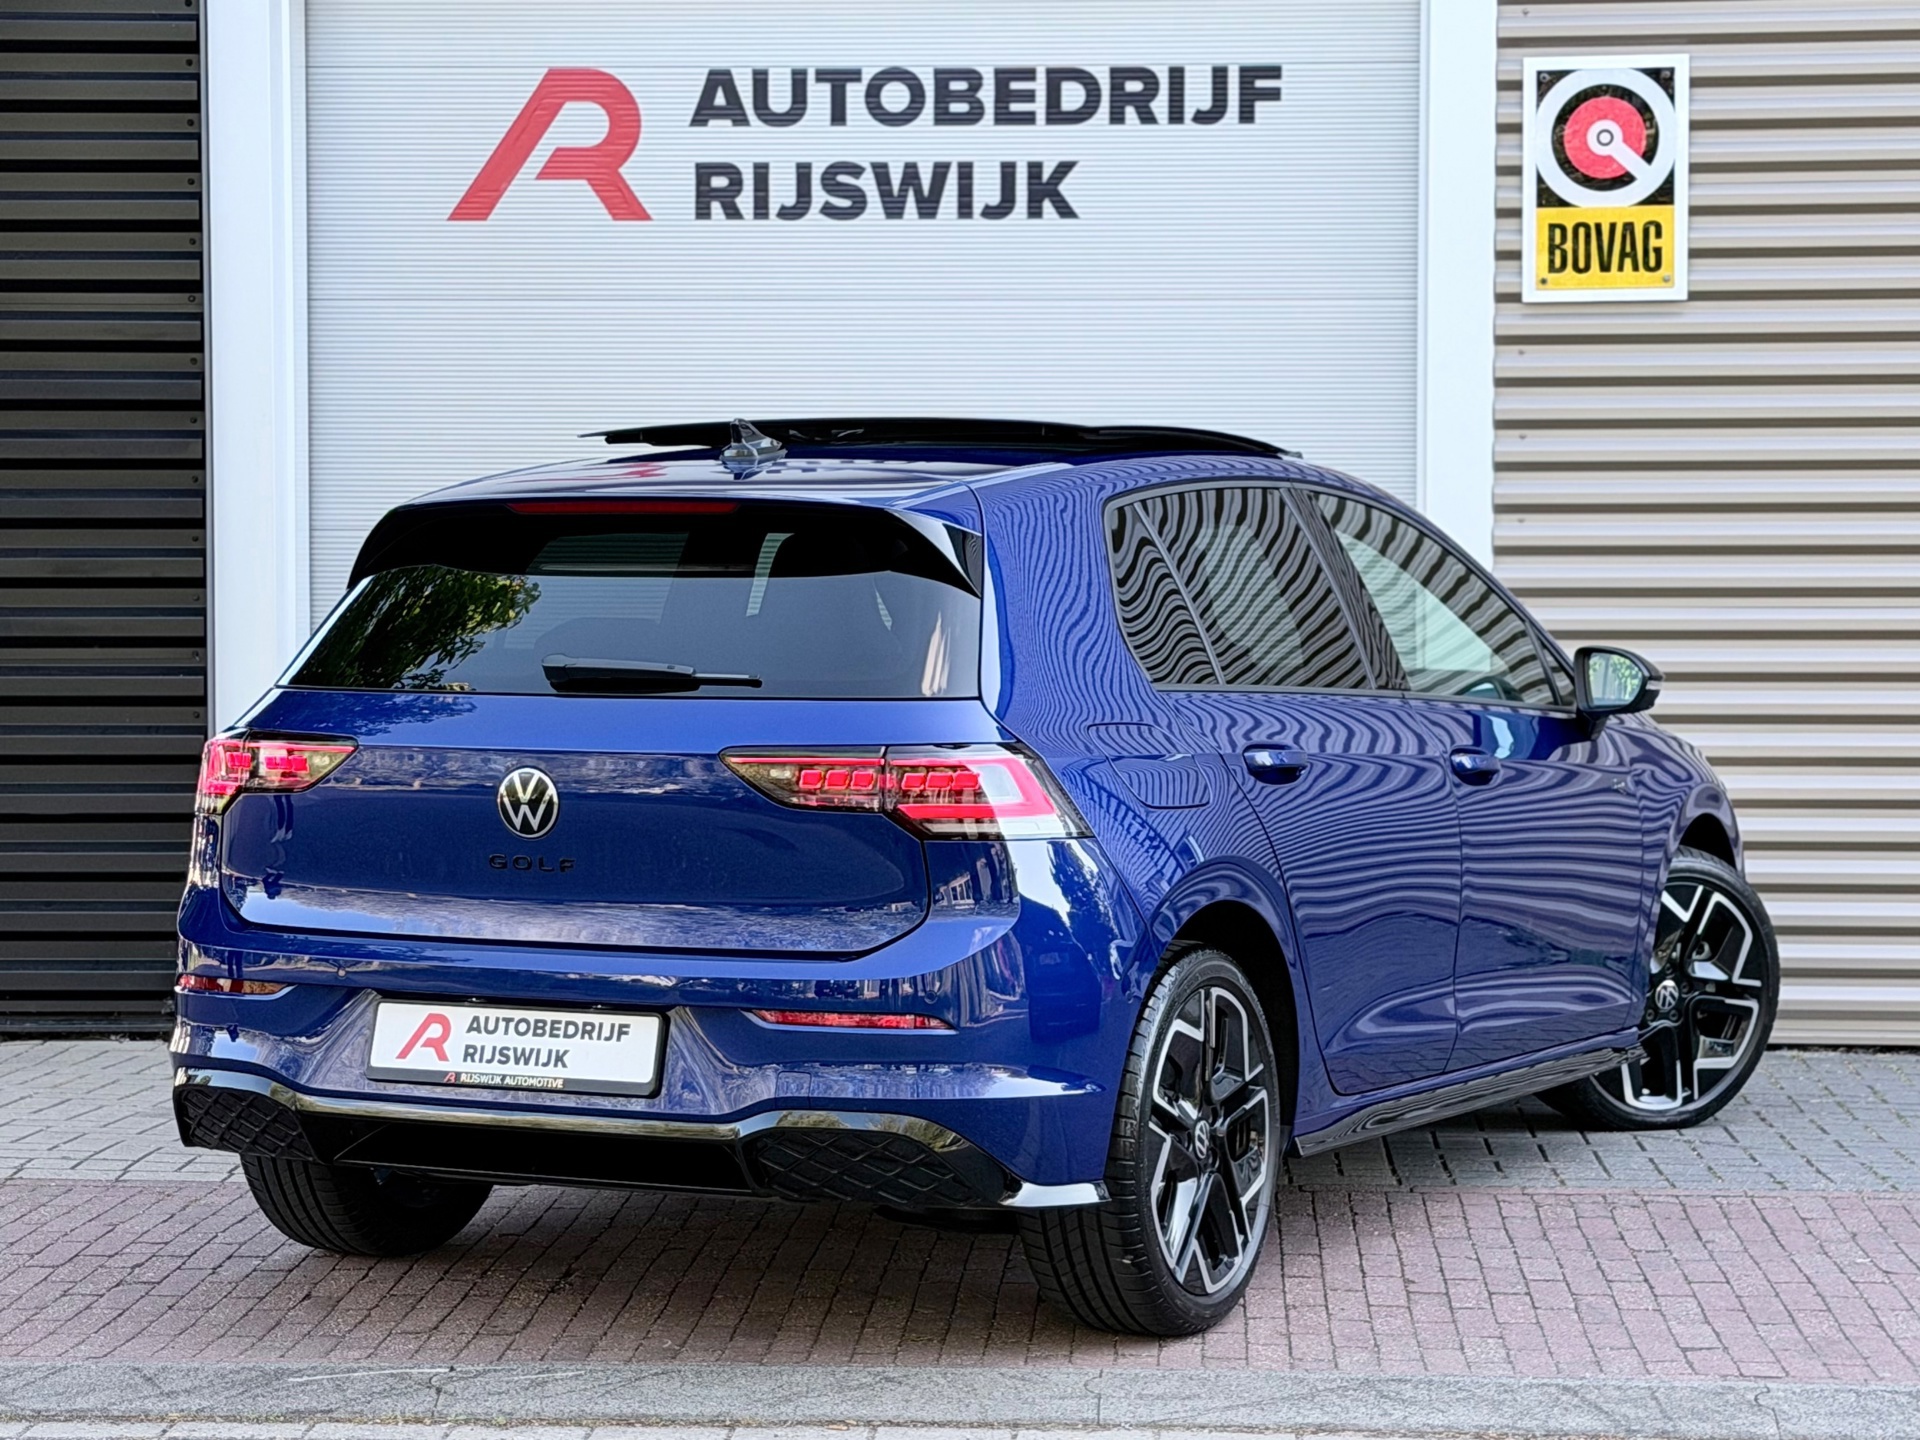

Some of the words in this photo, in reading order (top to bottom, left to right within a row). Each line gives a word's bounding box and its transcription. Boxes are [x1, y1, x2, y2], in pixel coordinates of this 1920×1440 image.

[690, 65, 1282, 126] AUTOBEDRIJF
[694, 160, 1079, 221] RIJSWIJK
[1547, 220, 1663, 273] BOVAG
[488, 853, 576, 872] GOLF
[466, 1015, 631, 1042] AUTOBEDRIJF
[462, 1044, 570, 1068] RIJSWIJK
[460, 1073, 502, 1083] RIJSWIJK
[504, 1075, 564, 1088] AUTOMOTIVE
